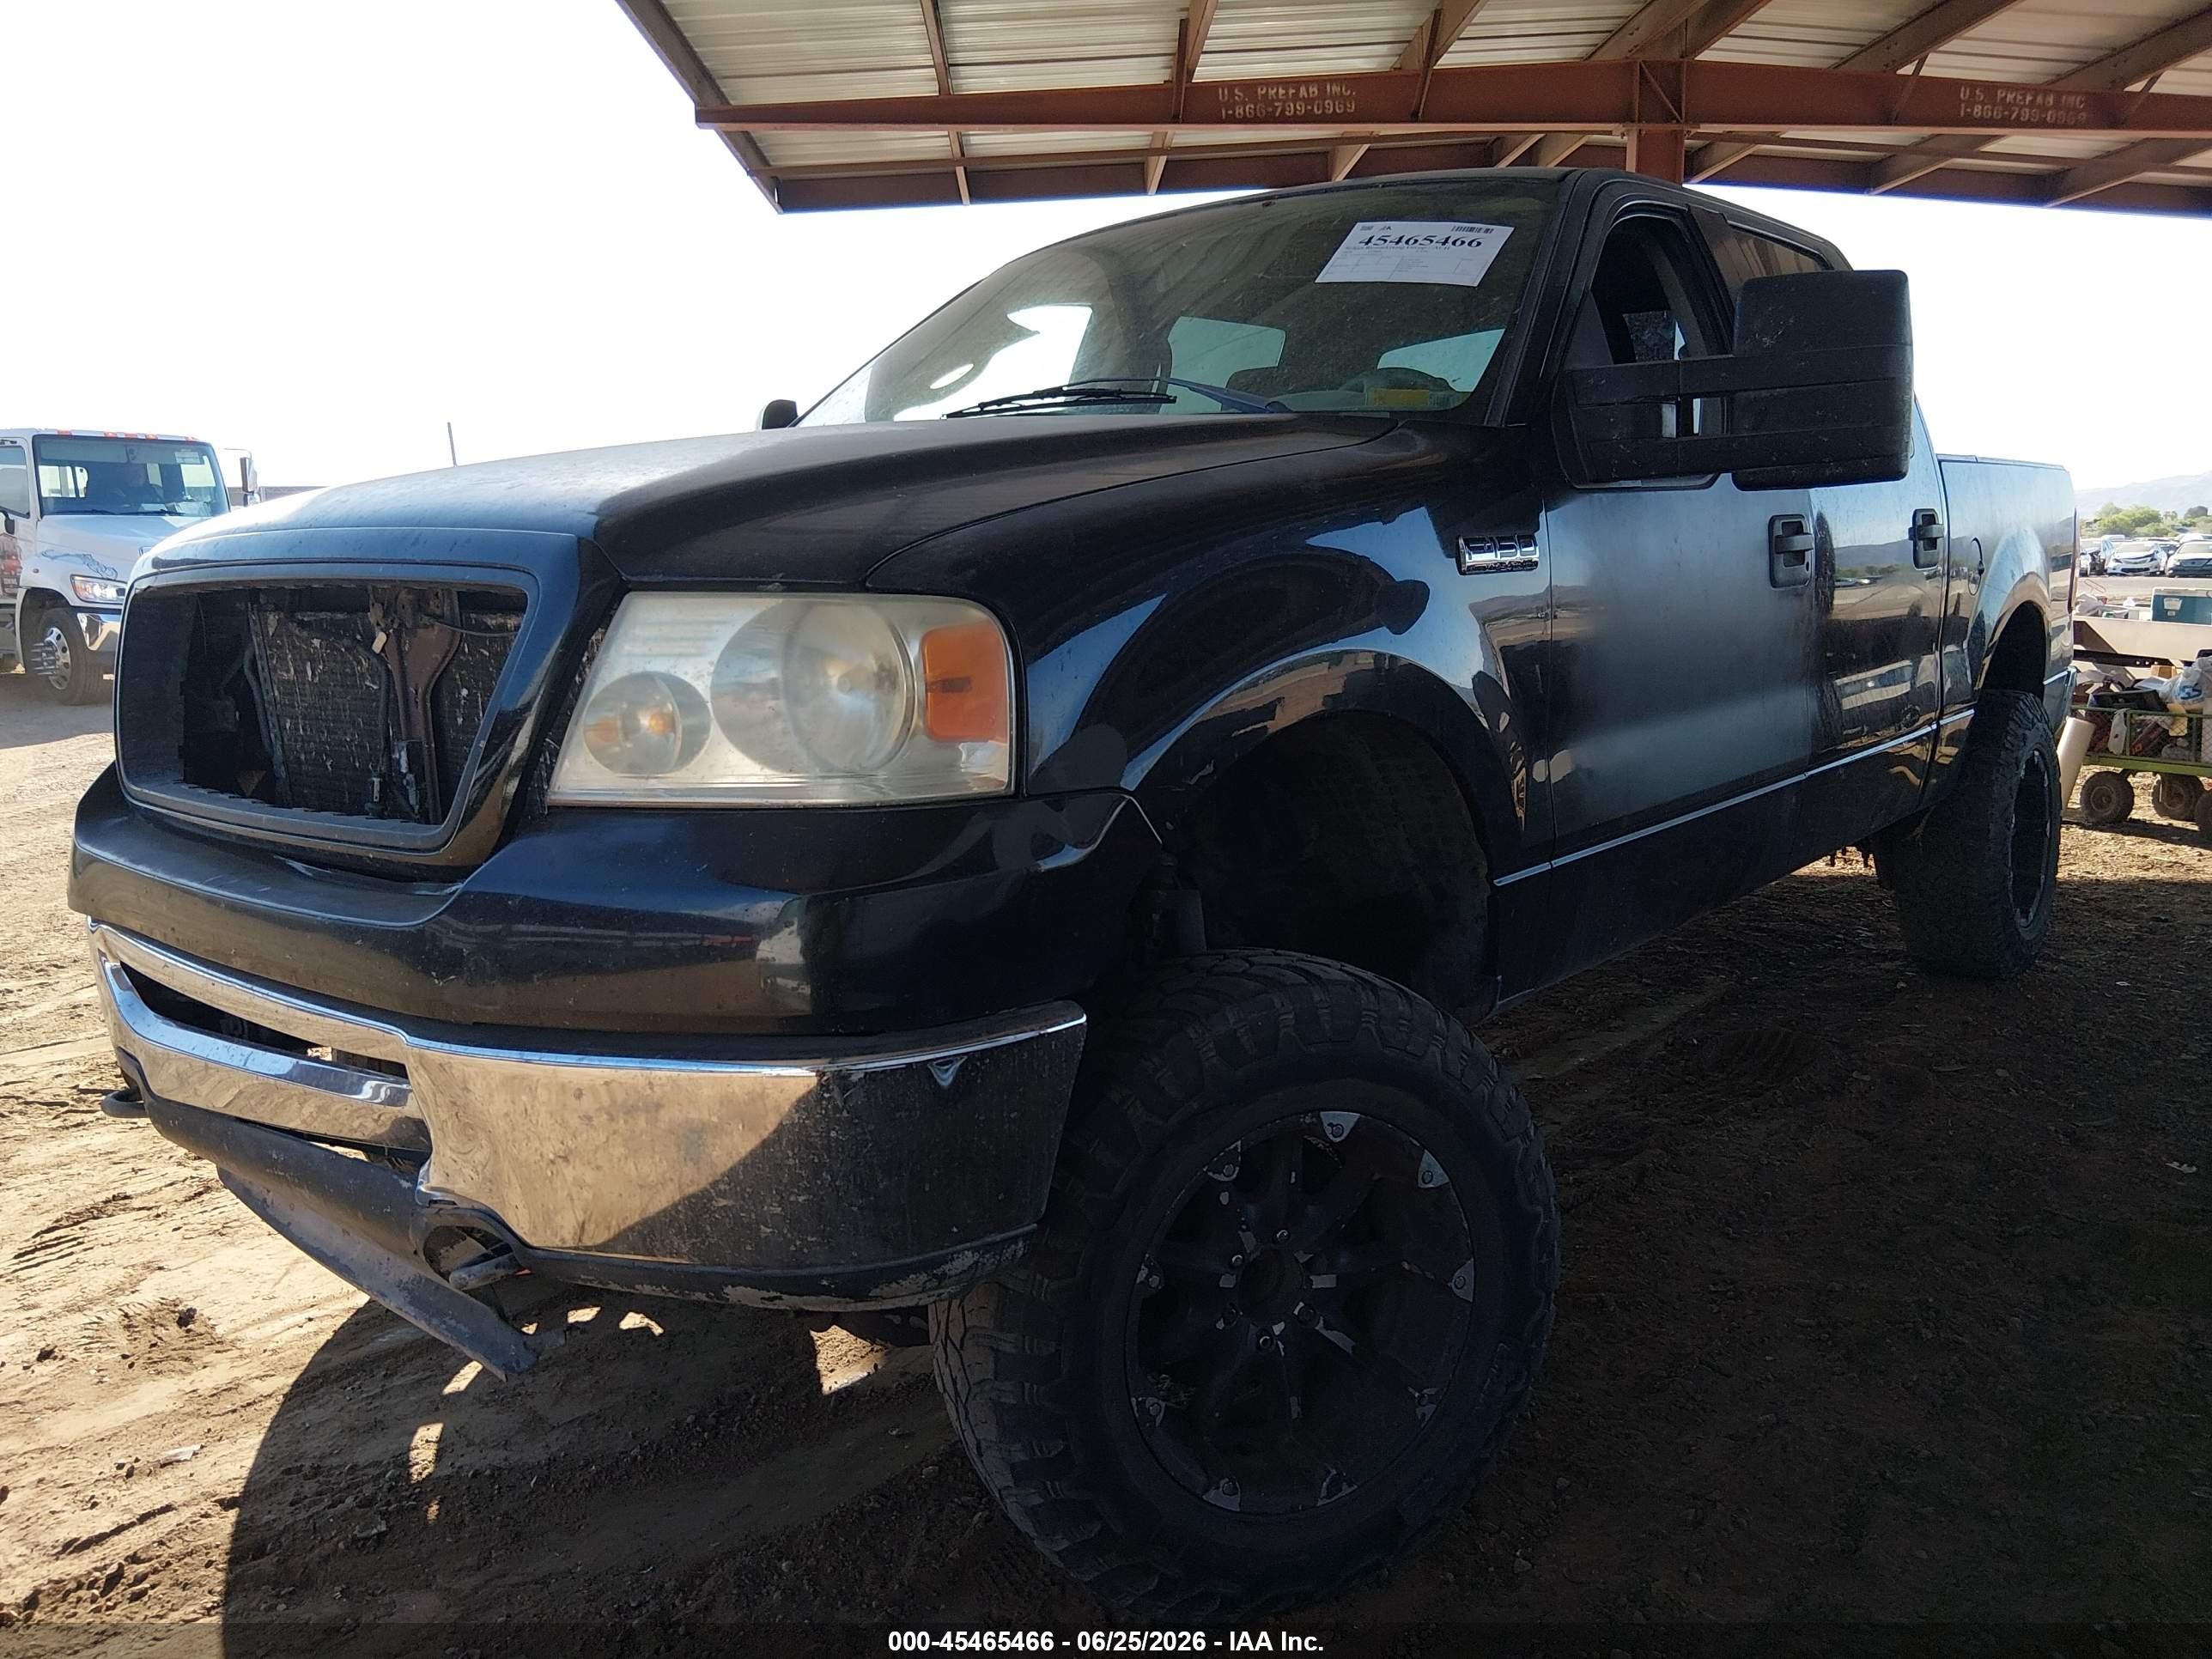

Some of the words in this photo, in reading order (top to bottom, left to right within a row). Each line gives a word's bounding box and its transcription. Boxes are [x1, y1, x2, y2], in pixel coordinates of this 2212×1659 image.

[1218, 87, 1249, 101] U.S.
[1257, 83, 1318, 100] PREFAB
[1326, 82, 1357, 96] INC.
[1996, 88, 2054, 106] PREFAB
[1221, 99, 1356, 118] 1-866-799-0969
[1358, 234, 1484, 248] 45465466
